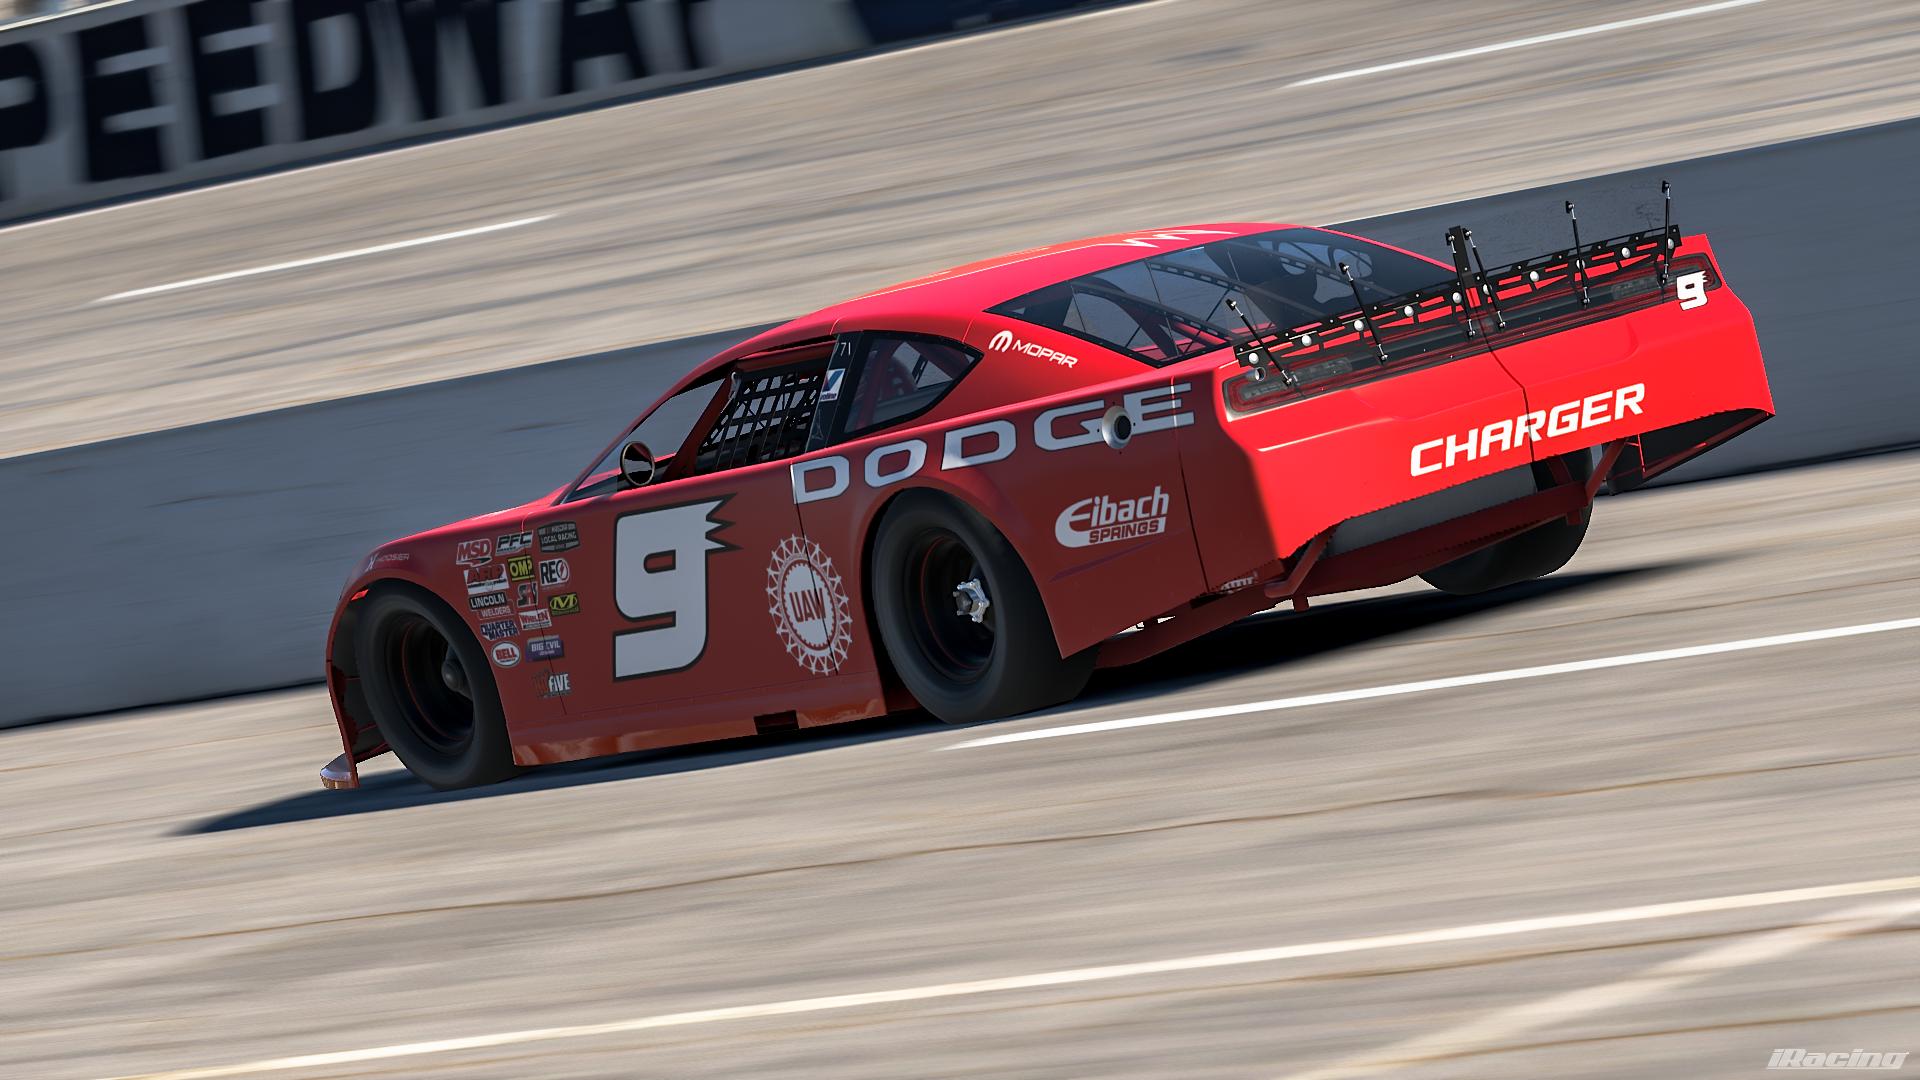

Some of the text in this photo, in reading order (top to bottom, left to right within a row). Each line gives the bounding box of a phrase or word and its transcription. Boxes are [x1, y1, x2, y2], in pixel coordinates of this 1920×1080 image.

[1676, 270, 1708, 311] 9
[1012, 339, 1079, 369] MOPAR
[1411, 382, 1646, 477] CHARGER
[793, 383, 1195, 504] DODGE
[1055, 485, 1169, 548] Eibach
[498, 532, 533, 549] PFC
[1089, 519, 1159, 543] SPRINGS
[458, 539, 491, 561] MSD
[613, 496, 734, 680] 9
[470, 593, 506, 609] LINCOLN
[480, 605, 512, 618] WELDERS
[789, 588, 826, 623] UAW
[480, 620, 515, 635] QUARTER
[488, 628, 519, 641] MASTER
[496, 648, 517, 661] BELL
[531, 643, 544, 653] BIG
